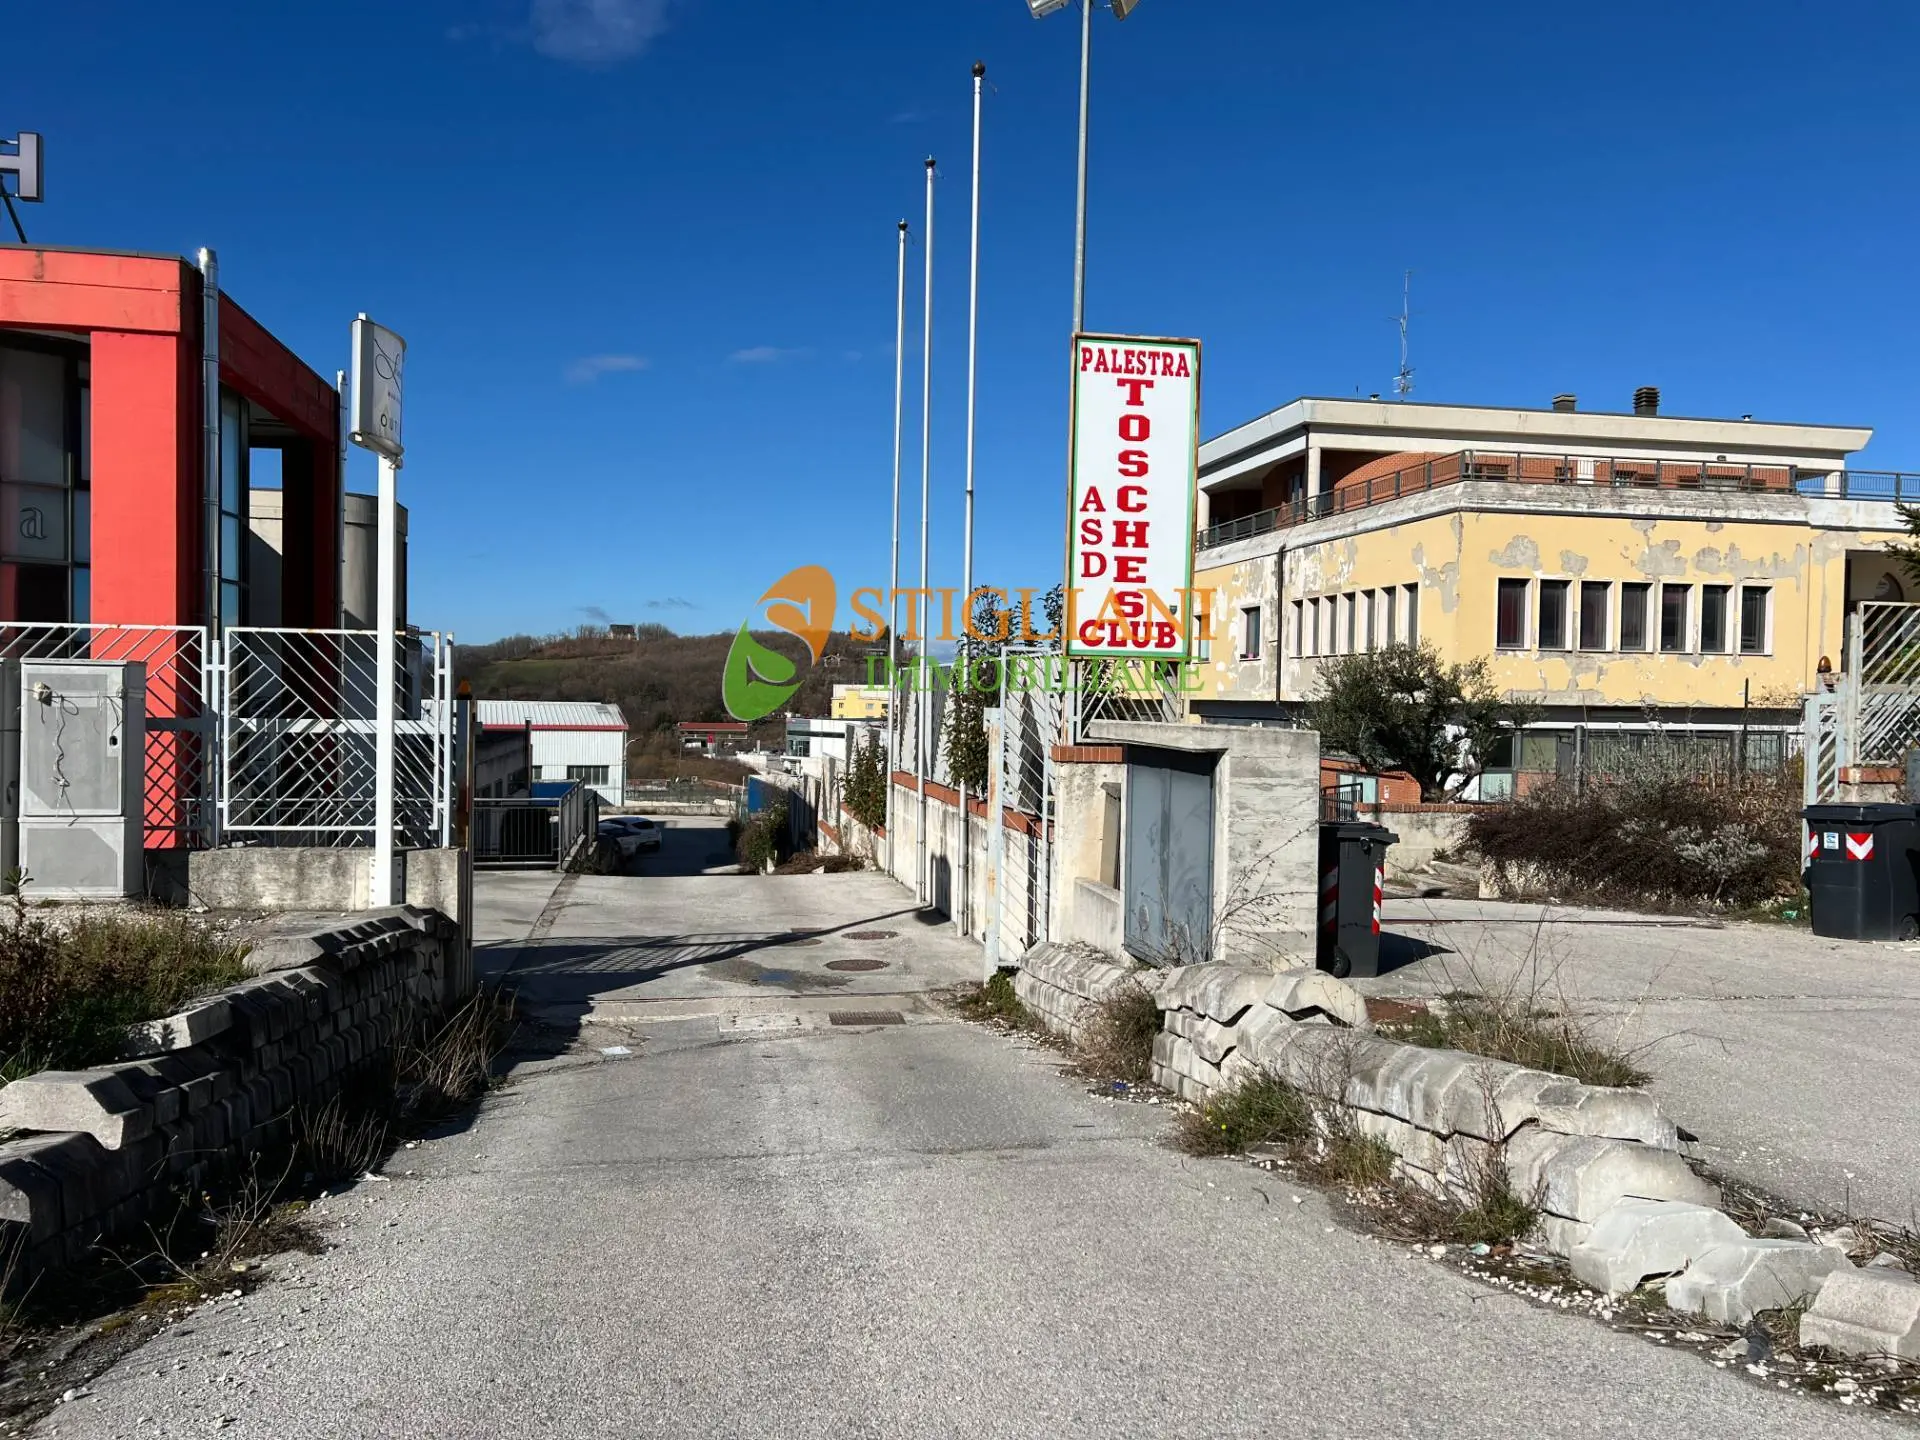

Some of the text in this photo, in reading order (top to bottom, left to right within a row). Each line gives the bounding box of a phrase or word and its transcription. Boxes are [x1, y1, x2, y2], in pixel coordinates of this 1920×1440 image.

[1081, 347, 1190, 377] PALESTRA
[1112, 378, 1154, 618] TOSCHES
[1080, 486, 1107, 578] ASD
[1079, 619, 1176, 649] CLUB
